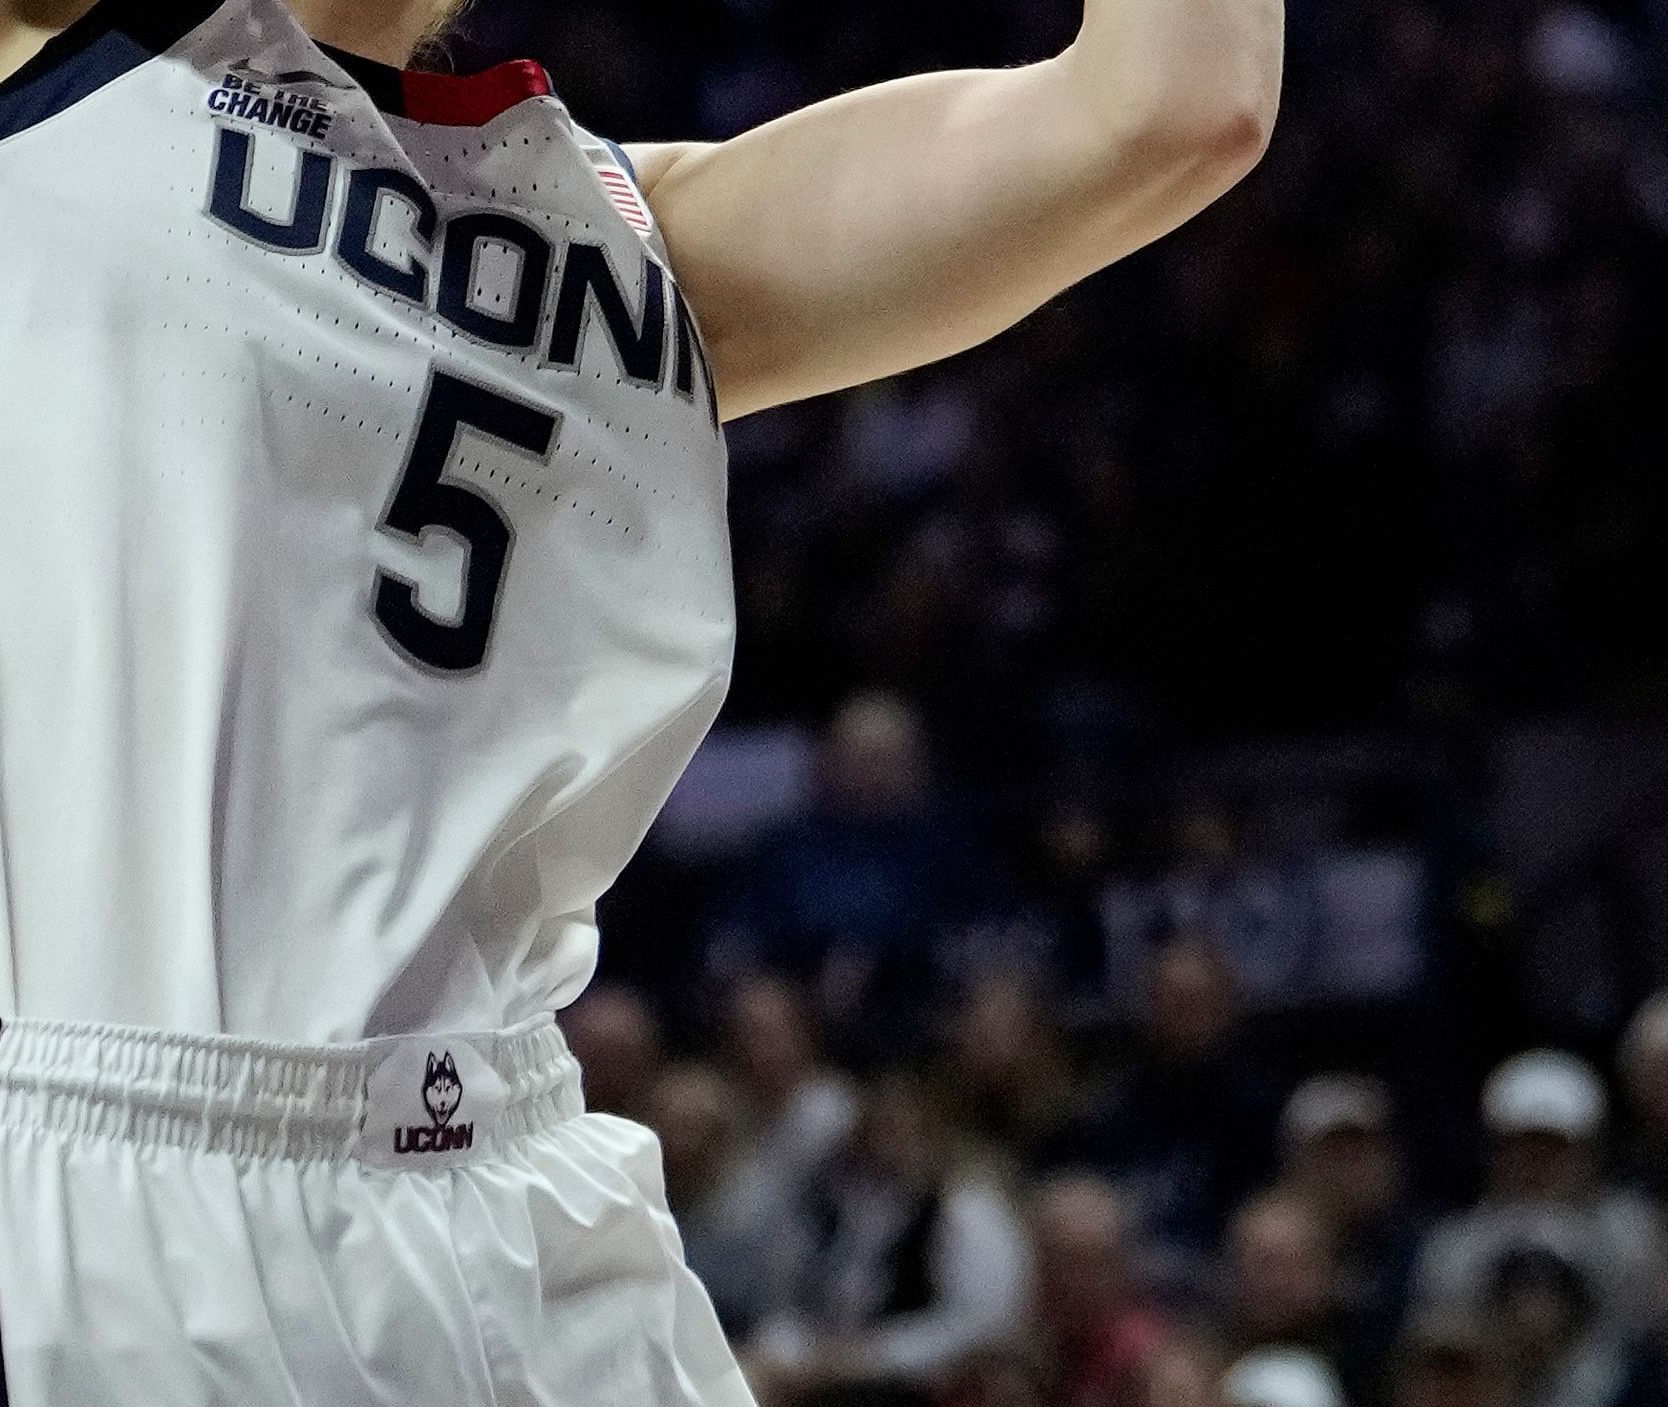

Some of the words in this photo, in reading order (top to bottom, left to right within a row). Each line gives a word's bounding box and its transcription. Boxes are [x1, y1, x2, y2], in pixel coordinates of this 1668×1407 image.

[207, 88, 332, 140] CHANGE
[366, 360, 564, 679] 5
[394, 1122, 474, 1153] UCONN
